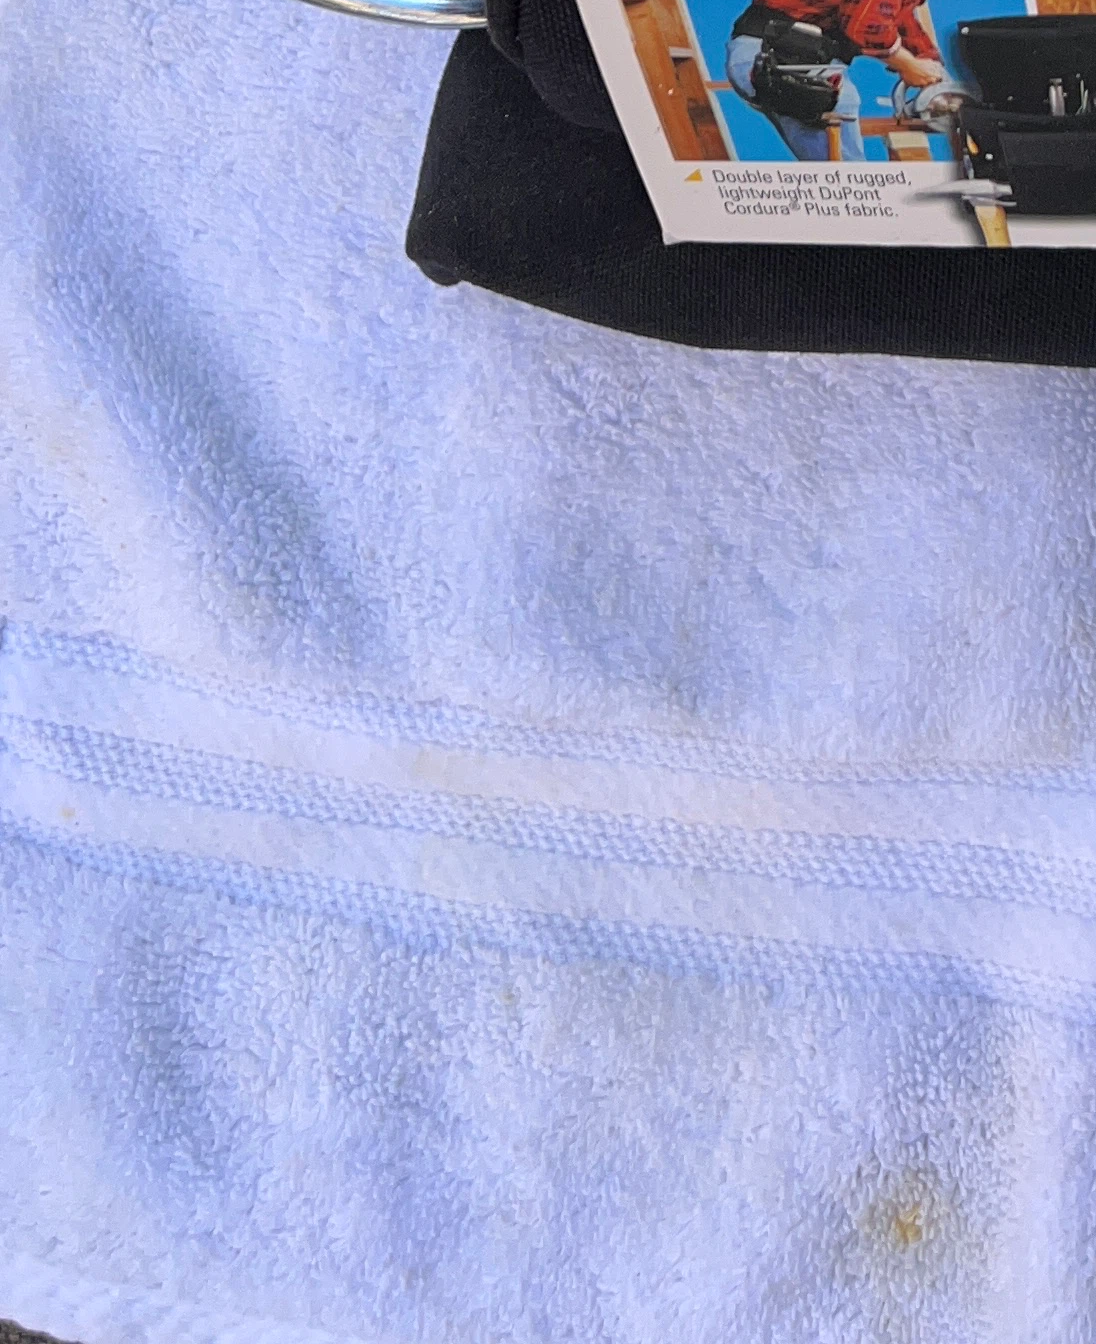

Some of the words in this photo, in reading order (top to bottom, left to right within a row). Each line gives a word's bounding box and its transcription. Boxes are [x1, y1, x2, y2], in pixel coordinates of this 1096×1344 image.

[712, 169, 773, 185] Double
[777, 169, 819, 189] layer
[825, 168, 841, 185] of
[847, 170, 912, 189] rugged,
[718, 185, 814, 203] lightweight
[819, 185, 882, 202] DuPont
[805, 202, 840, 217] Plus
[844, 201, 899, 218] fabric.
